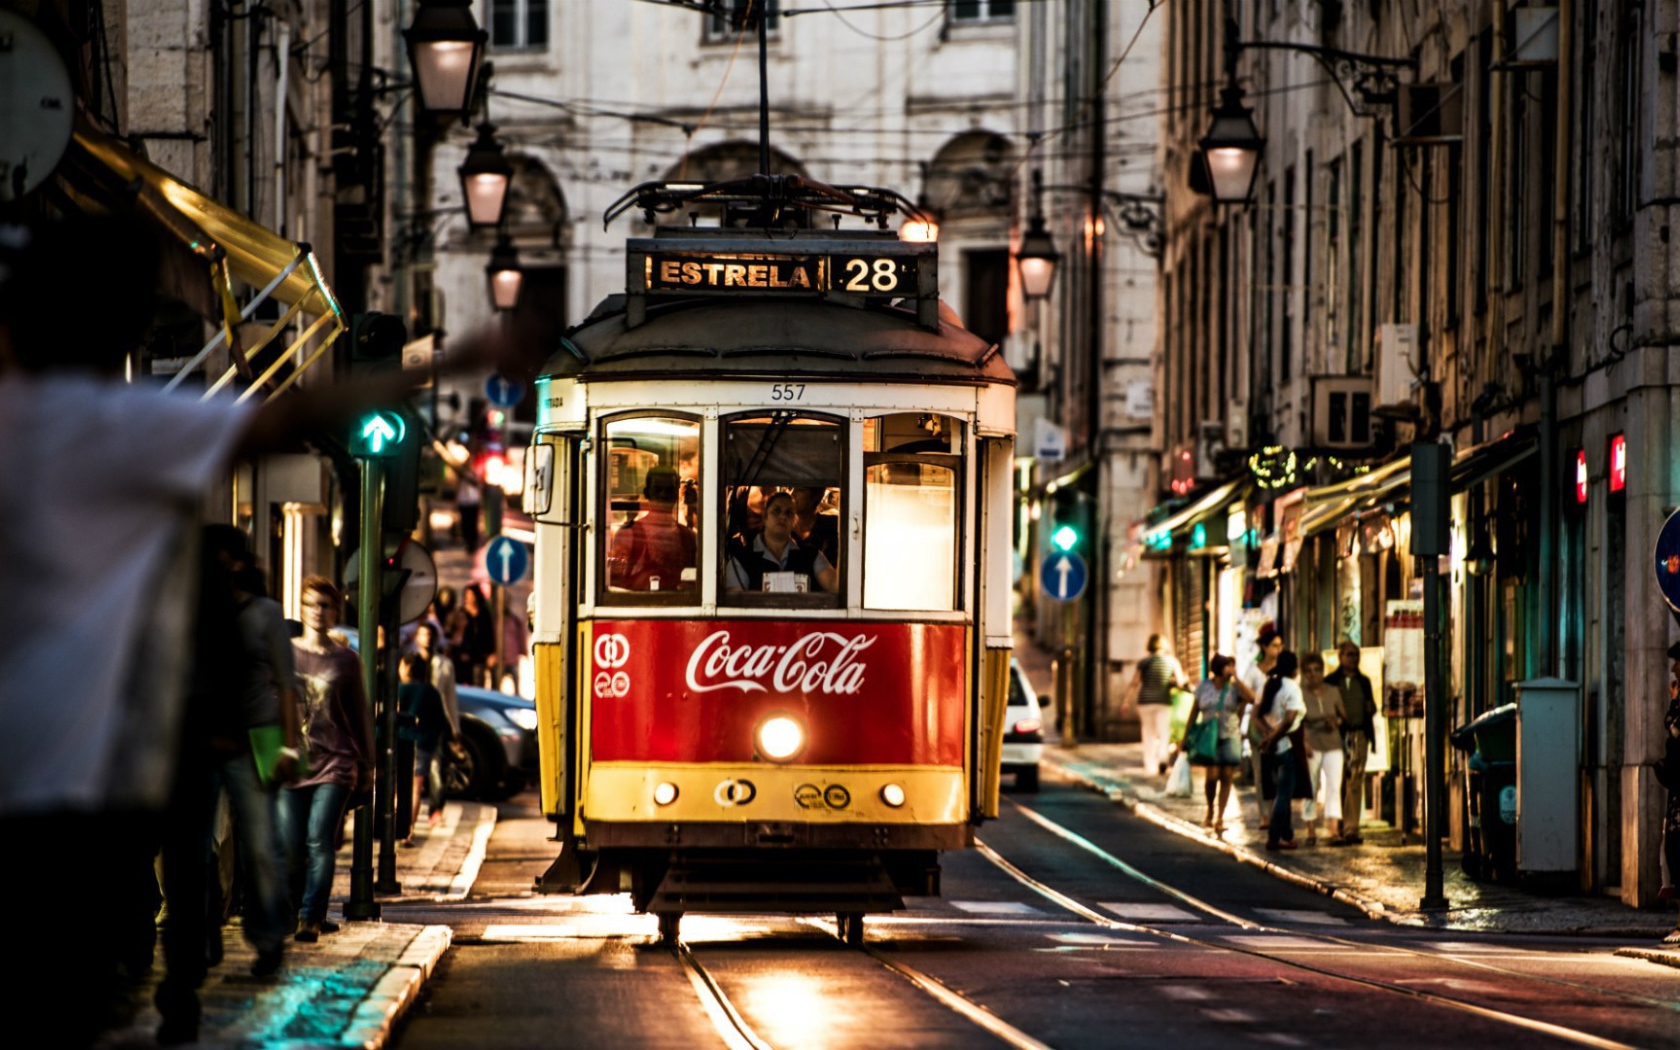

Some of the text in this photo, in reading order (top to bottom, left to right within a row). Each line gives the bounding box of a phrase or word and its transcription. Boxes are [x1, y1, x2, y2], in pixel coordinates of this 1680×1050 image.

[660, 260, 811, 288] ESTRELA
[845, 258, 899, 292] 28
[771, 383, 806, 401] 557
[685, 630, 879, 695] Coca-Cola
